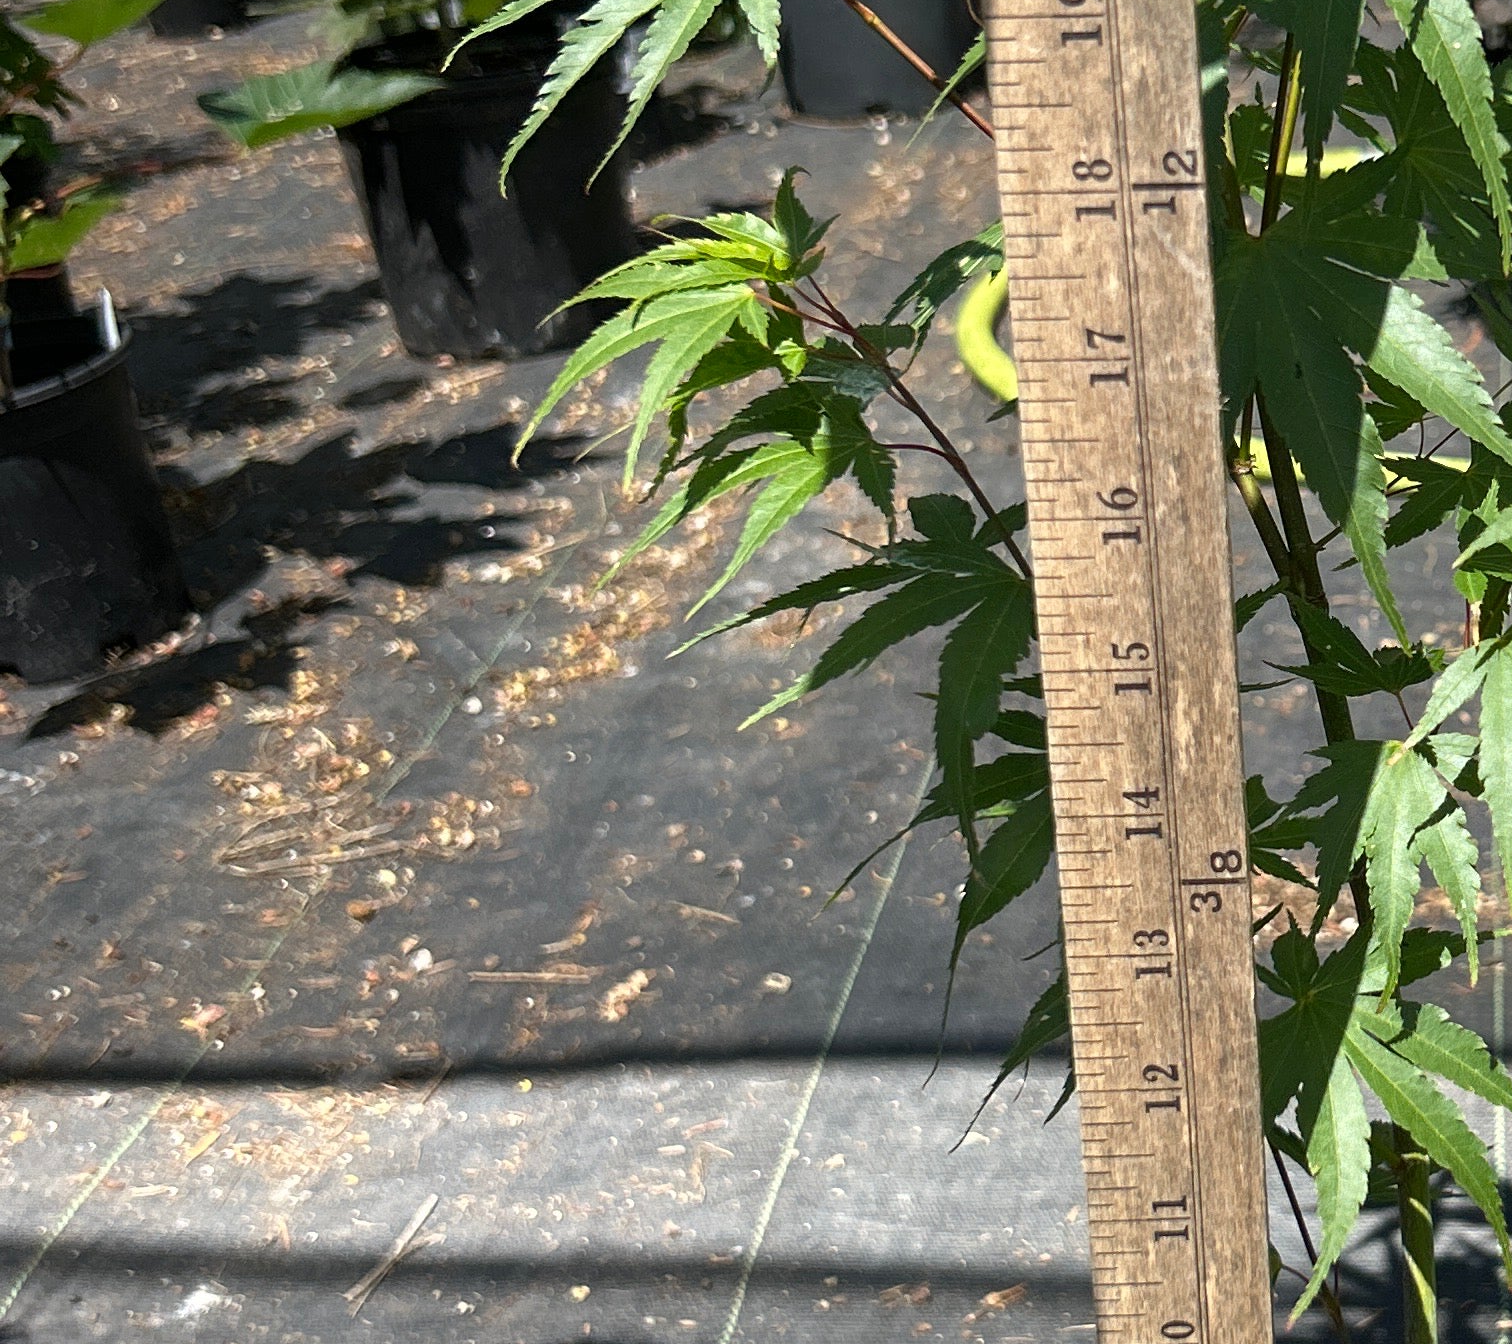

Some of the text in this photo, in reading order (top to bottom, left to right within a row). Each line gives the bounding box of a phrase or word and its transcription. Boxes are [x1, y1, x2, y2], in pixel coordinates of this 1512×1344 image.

[1072, 158, 1118, 223] 18
[1086, 327, 1131, 388] 17
[1096, 486, 1142, 546] 16
[1111, 641, 1153, 696] 15
[1122, 786, 1164, 842] 14
[1133, 928, 1172, 980] 13
[1142, 1063, 1182, 1114] 12
[1151, 1194, 1190, 1243] 11
